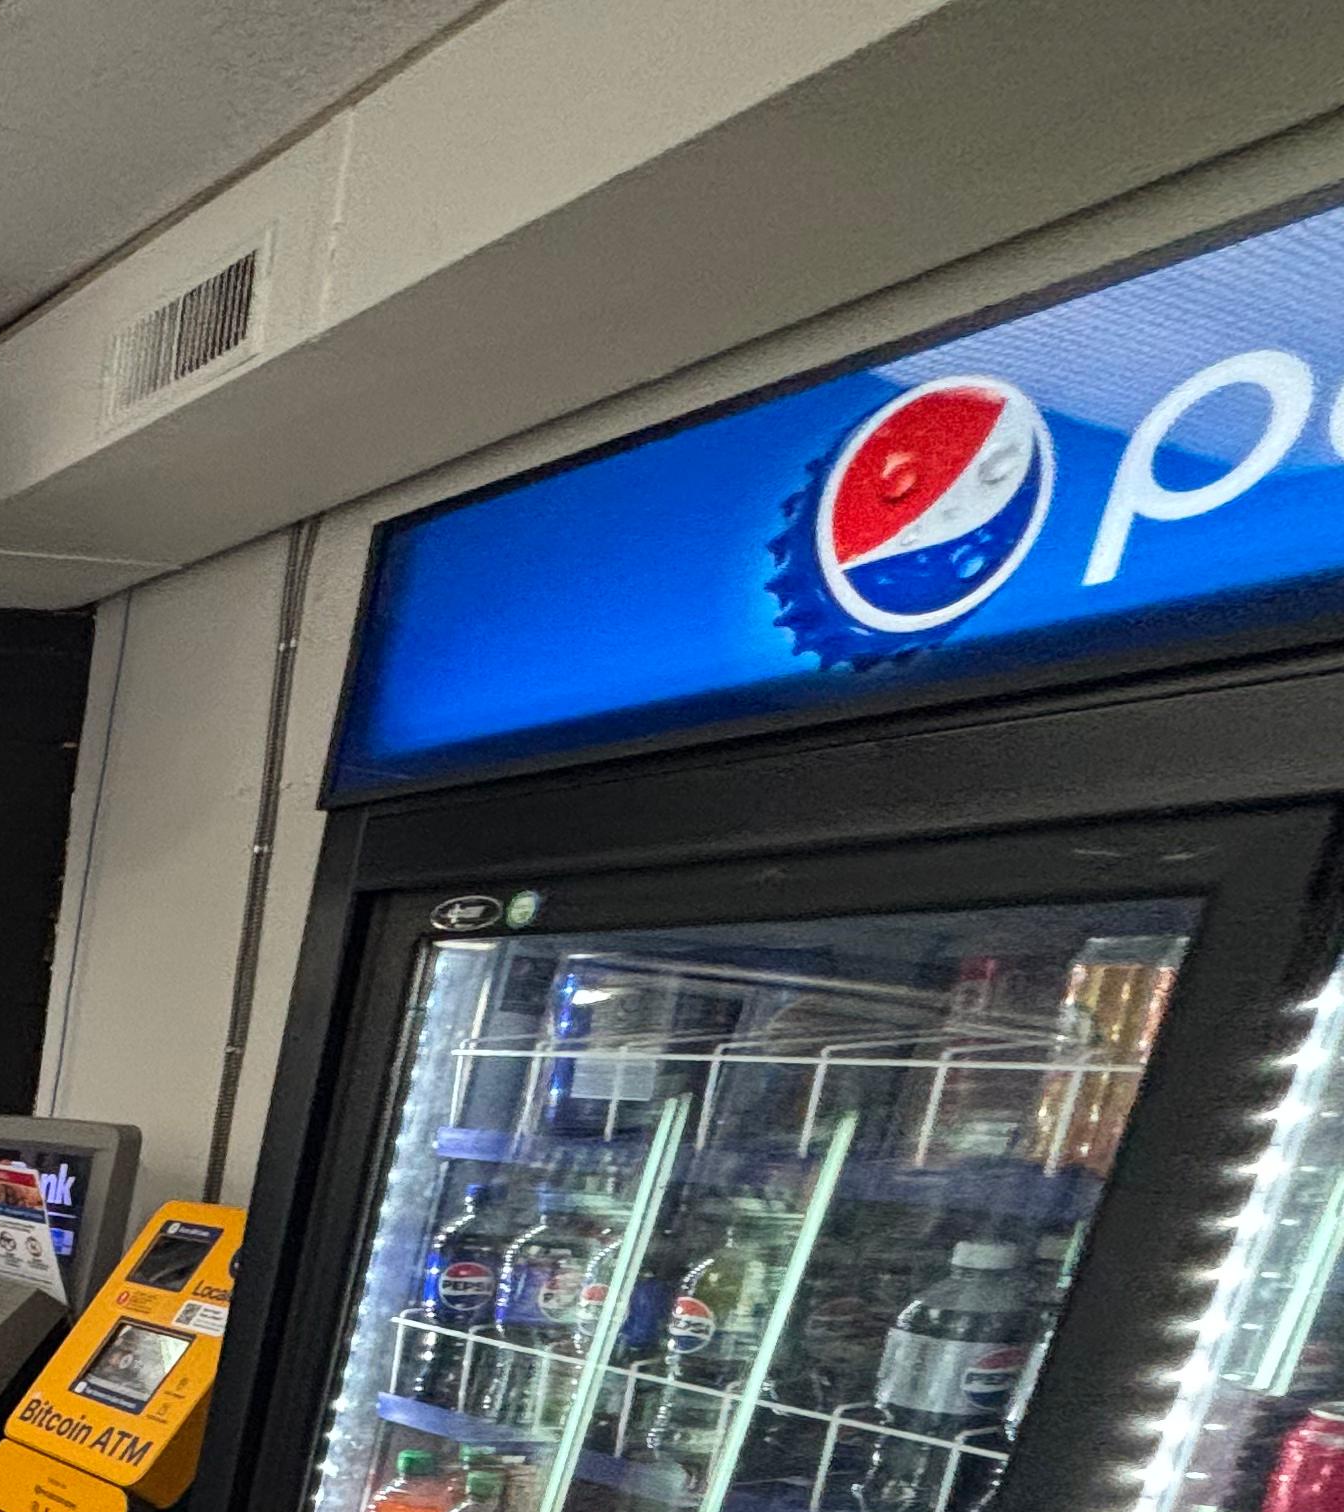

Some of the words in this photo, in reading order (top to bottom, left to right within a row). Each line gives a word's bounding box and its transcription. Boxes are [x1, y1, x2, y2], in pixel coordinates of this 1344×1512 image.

[1082, 347, 1344, 586] p
[19, 1398, 93, 1446] Bitcoin
[90, 1426, 154, 1468] ATM
